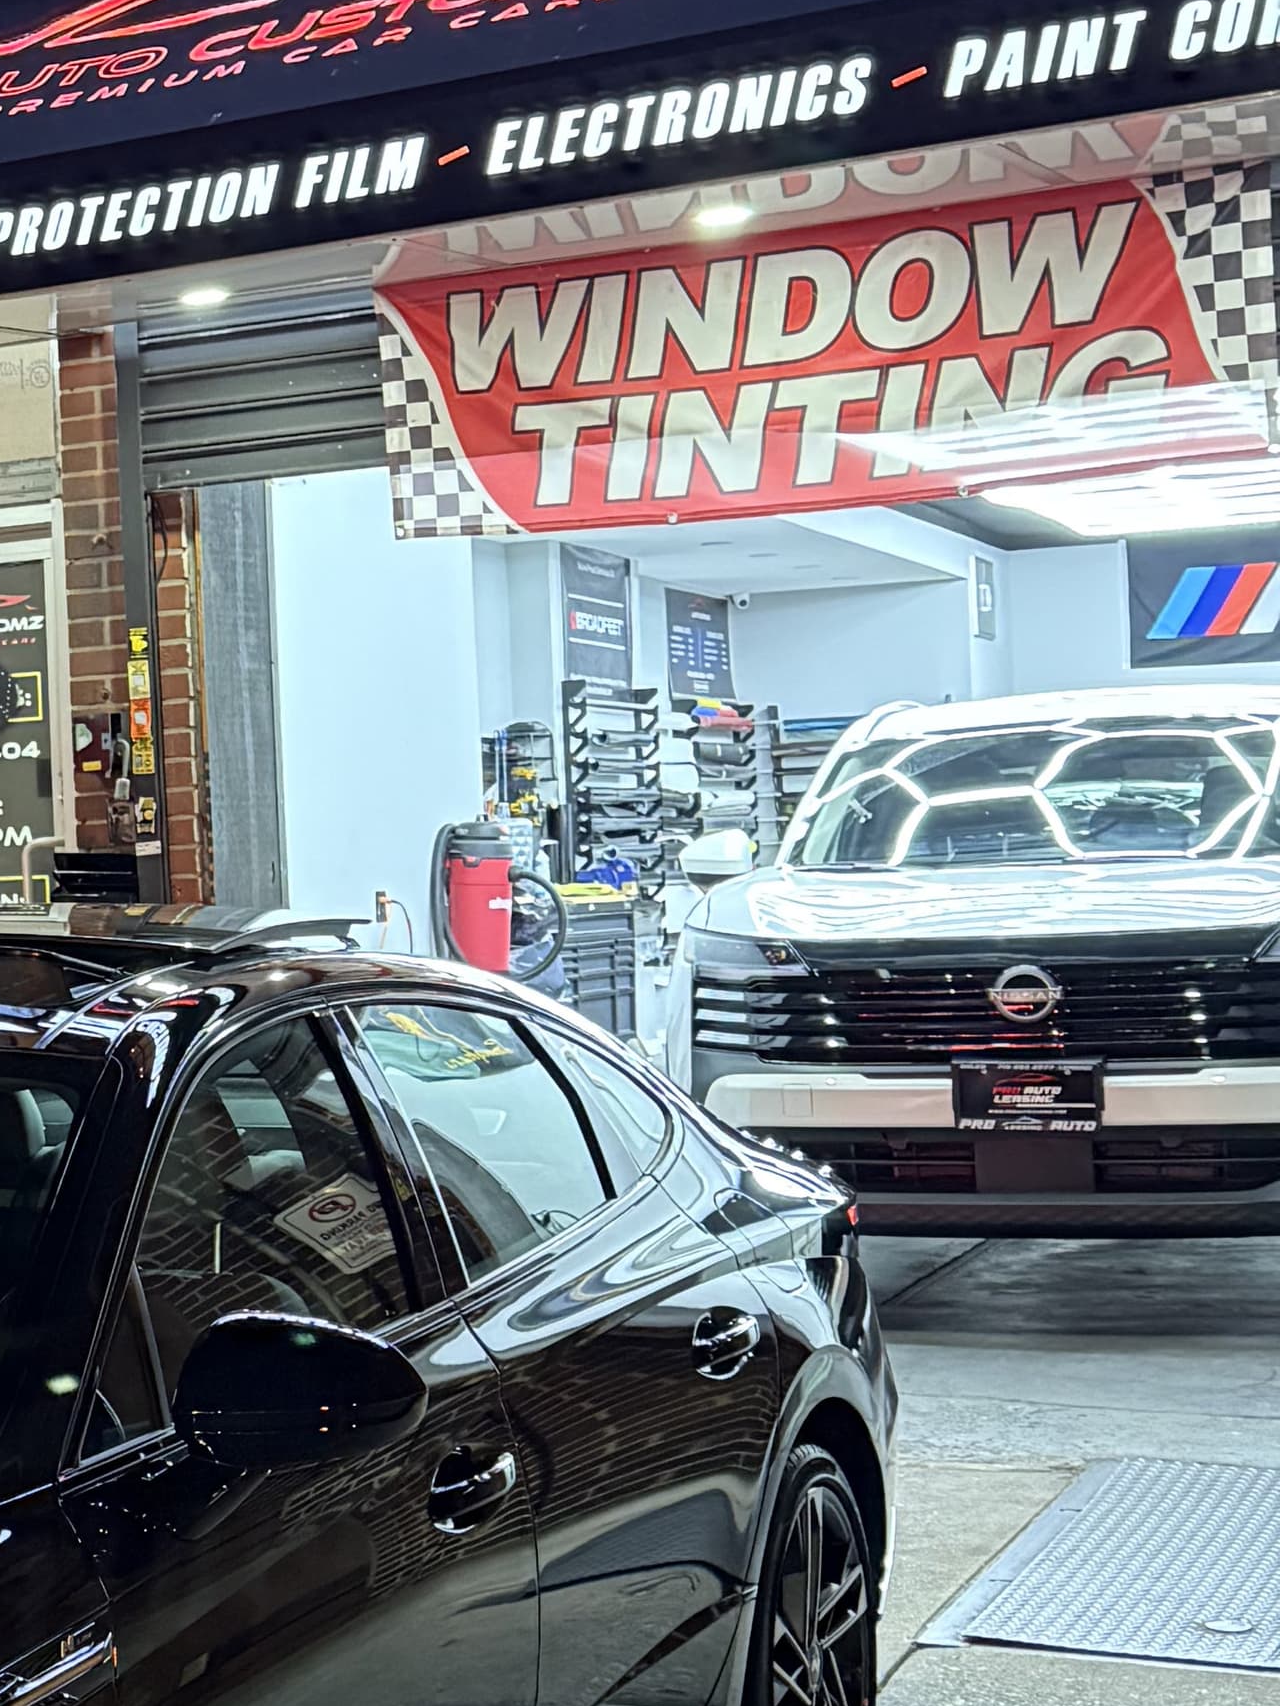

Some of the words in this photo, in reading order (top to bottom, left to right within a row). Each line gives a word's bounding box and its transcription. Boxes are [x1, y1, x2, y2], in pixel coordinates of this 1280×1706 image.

[281, 26, 414, 65] CAR
[293, 133, 429, 211] FILM
[485, 56, 872, 177] ELECTRONICS
[943, 9, 1147, 98] PAINT
[446, 197, 1142, 393] WINDOW
[515, 328, 1171, 509] TINTING
[993, 1095, 1055, 1103] LEASING
[1024, 1086, 1062, 1095] AUTO
[959, 1119, 996, 1130] PRO
[1050, 1121, 1097, 1132] AUTO
